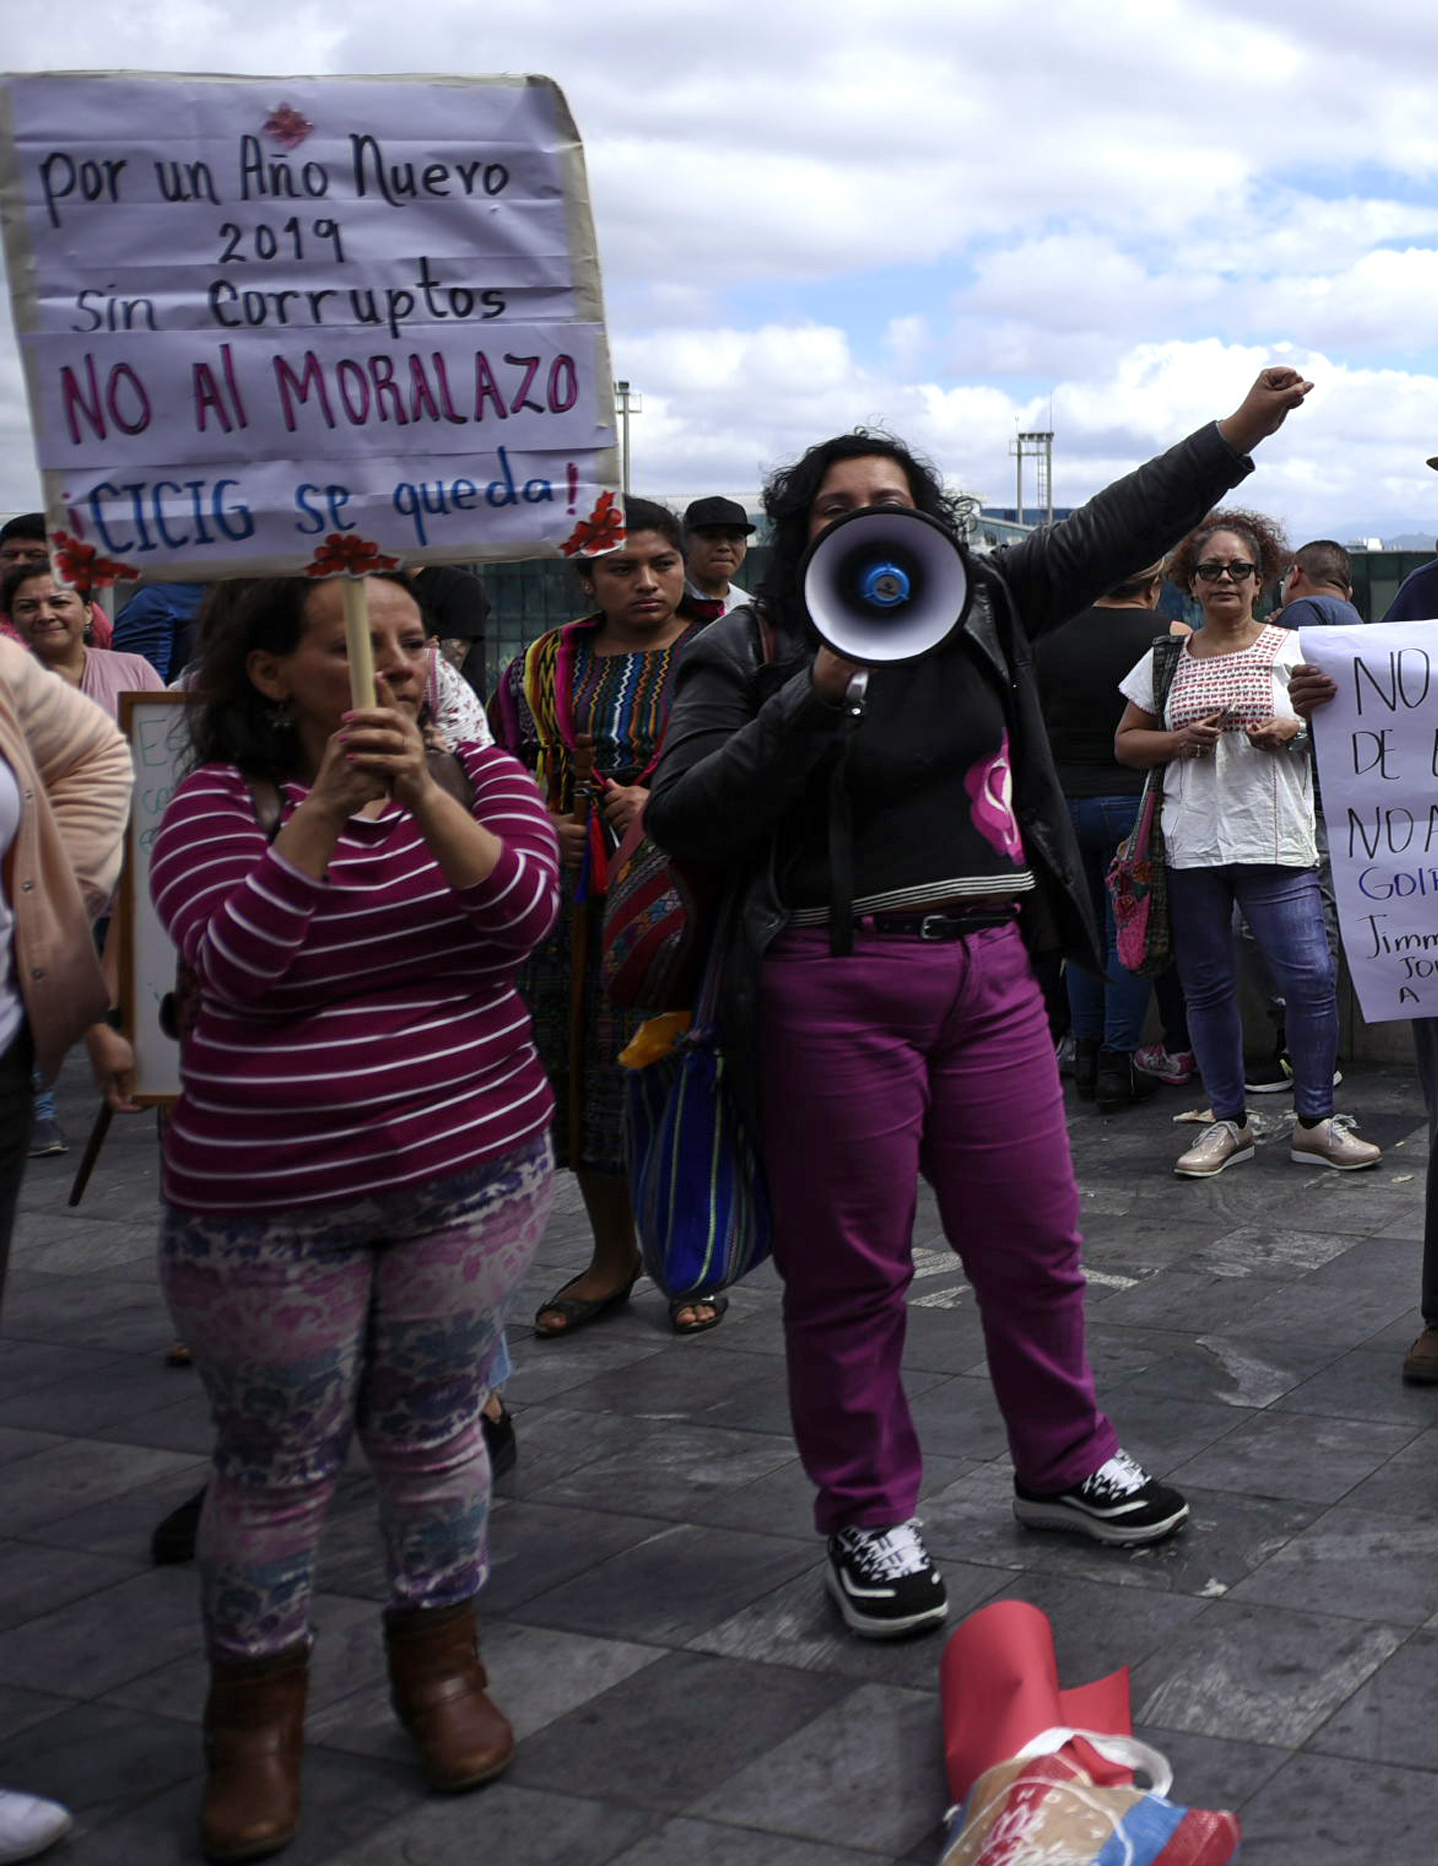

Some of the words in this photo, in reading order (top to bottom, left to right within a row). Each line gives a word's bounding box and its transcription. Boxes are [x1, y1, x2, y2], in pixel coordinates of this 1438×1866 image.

[153, 160, 221, 206] un
[239, 133, 329, 203] Año
[349, 133, 510, 207] Nuevo
[218, 217, 347, 265] 2019
[207, 256, 507, 339] Corruptos
[59, 353, 151, 445] NO
[272, 350, 580, 433] MORALAZO
[294, 482, 357, 535] se
[391, 445, 580, 547] queda!
[1353, 647, 1431, 716] NO
[1352, 728, 1401, 780] DE
[1399, 986, 1420, 1004] A
